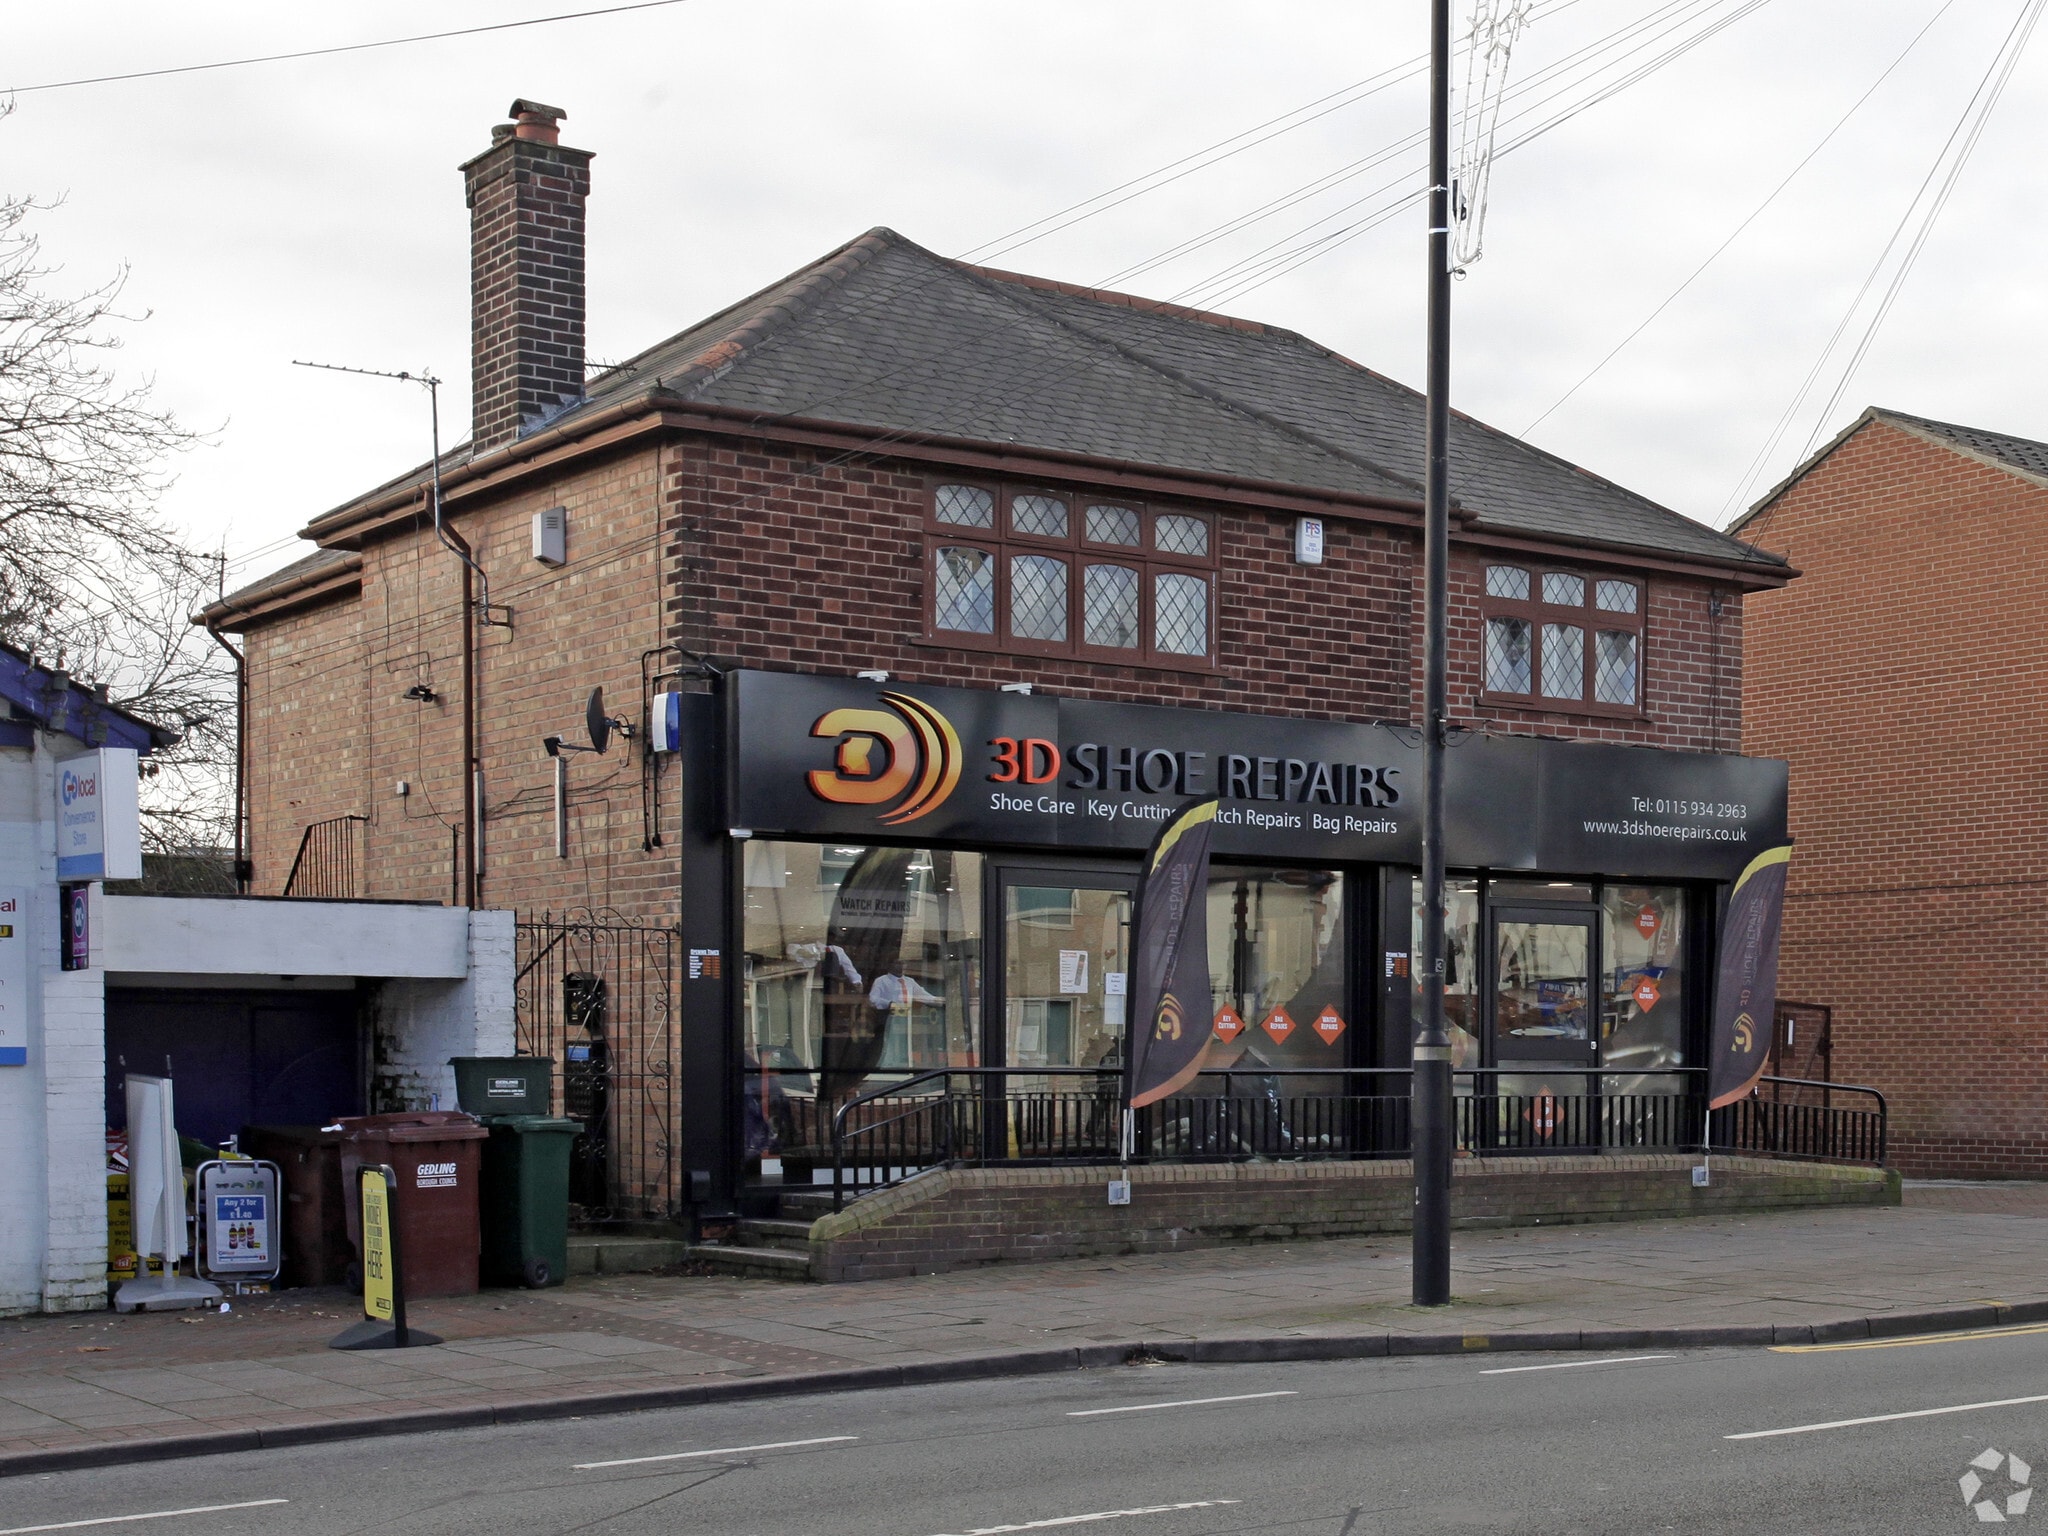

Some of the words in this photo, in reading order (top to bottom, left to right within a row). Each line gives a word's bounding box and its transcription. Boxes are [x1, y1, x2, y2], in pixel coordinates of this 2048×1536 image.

[987, 737, 1061, 784] 3D
[1068, 743, 1206, 795] SHOE
[1220, 754, 1400, 808] REPAIRS
[990, 793, 1033, 812] Shoe
[1037, 796, 1075, 814] Care
[1088, 799, 1117, 821] Key
[1122, 801, 1176, 820] Cuttin
[1632, 797, 1653, 813] Tel:
[1656, 799, 1687, 814] 0115
[1691, 801, 1713, 816] 934
[1717, 803, 1747, 818] 2963
[1213, 807, 1242, 824] tch
[1246, 809, 1301, 829] Repairs
[1313, 813, 1340, 834] Bag
[1345, 816, 1397, 835] Repairs
[1584, 820, 1747, 841] www.3dshoerepairs.co.uk
[0, 898, 16, 912] al
[417, 1163, 456, 1175] GEDLING
[417, 1178, 438, 1186] BOROUGH
[439, 1177, 457, 1185] COUNCIL
[224, 1199, 238, 1207] Any
[240, 1198, 245, 1206] 2
[247, 1198, 257, 1206] for
[230, 1206, 252, 1219] £1.40
